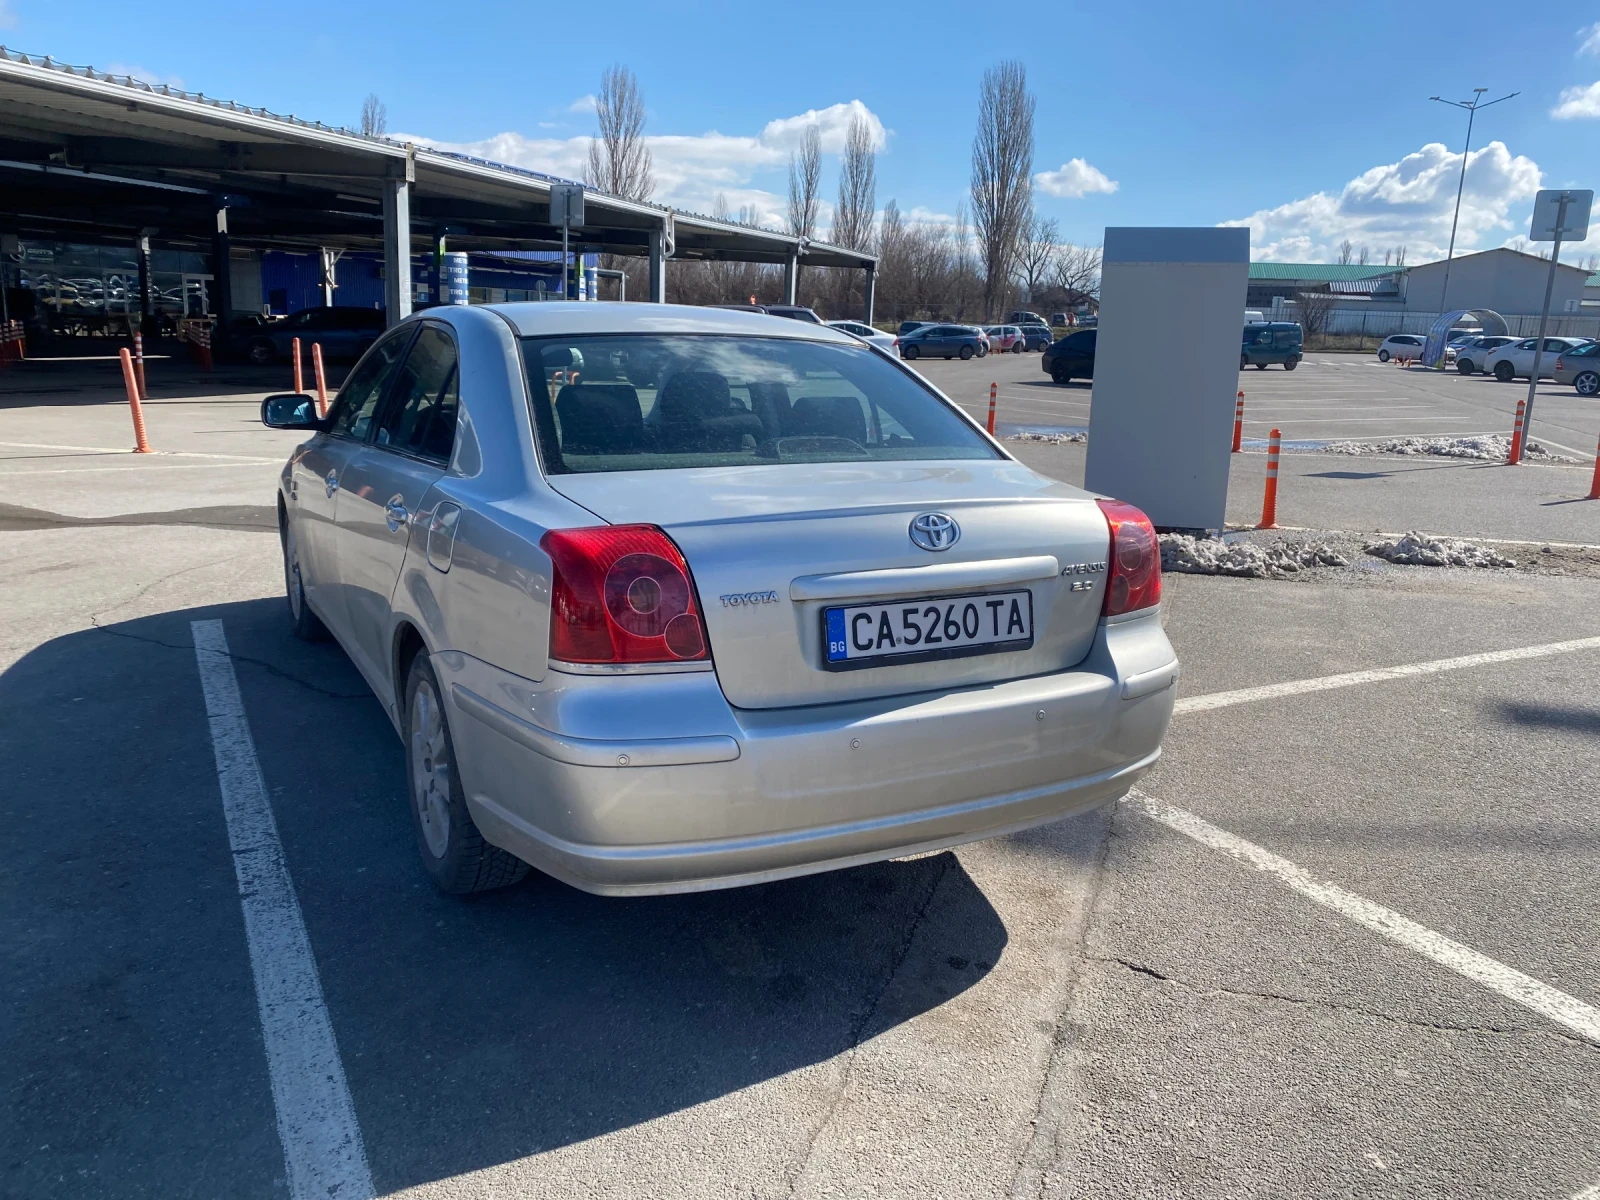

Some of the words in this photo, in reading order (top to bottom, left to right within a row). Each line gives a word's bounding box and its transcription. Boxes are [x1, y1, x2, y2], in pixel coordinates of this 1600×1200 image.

[1061, 561, 1106, 576] AVENSIS
[720, 590, 780, 607] TOYOTA
[830, 640, 845, 653] BG
